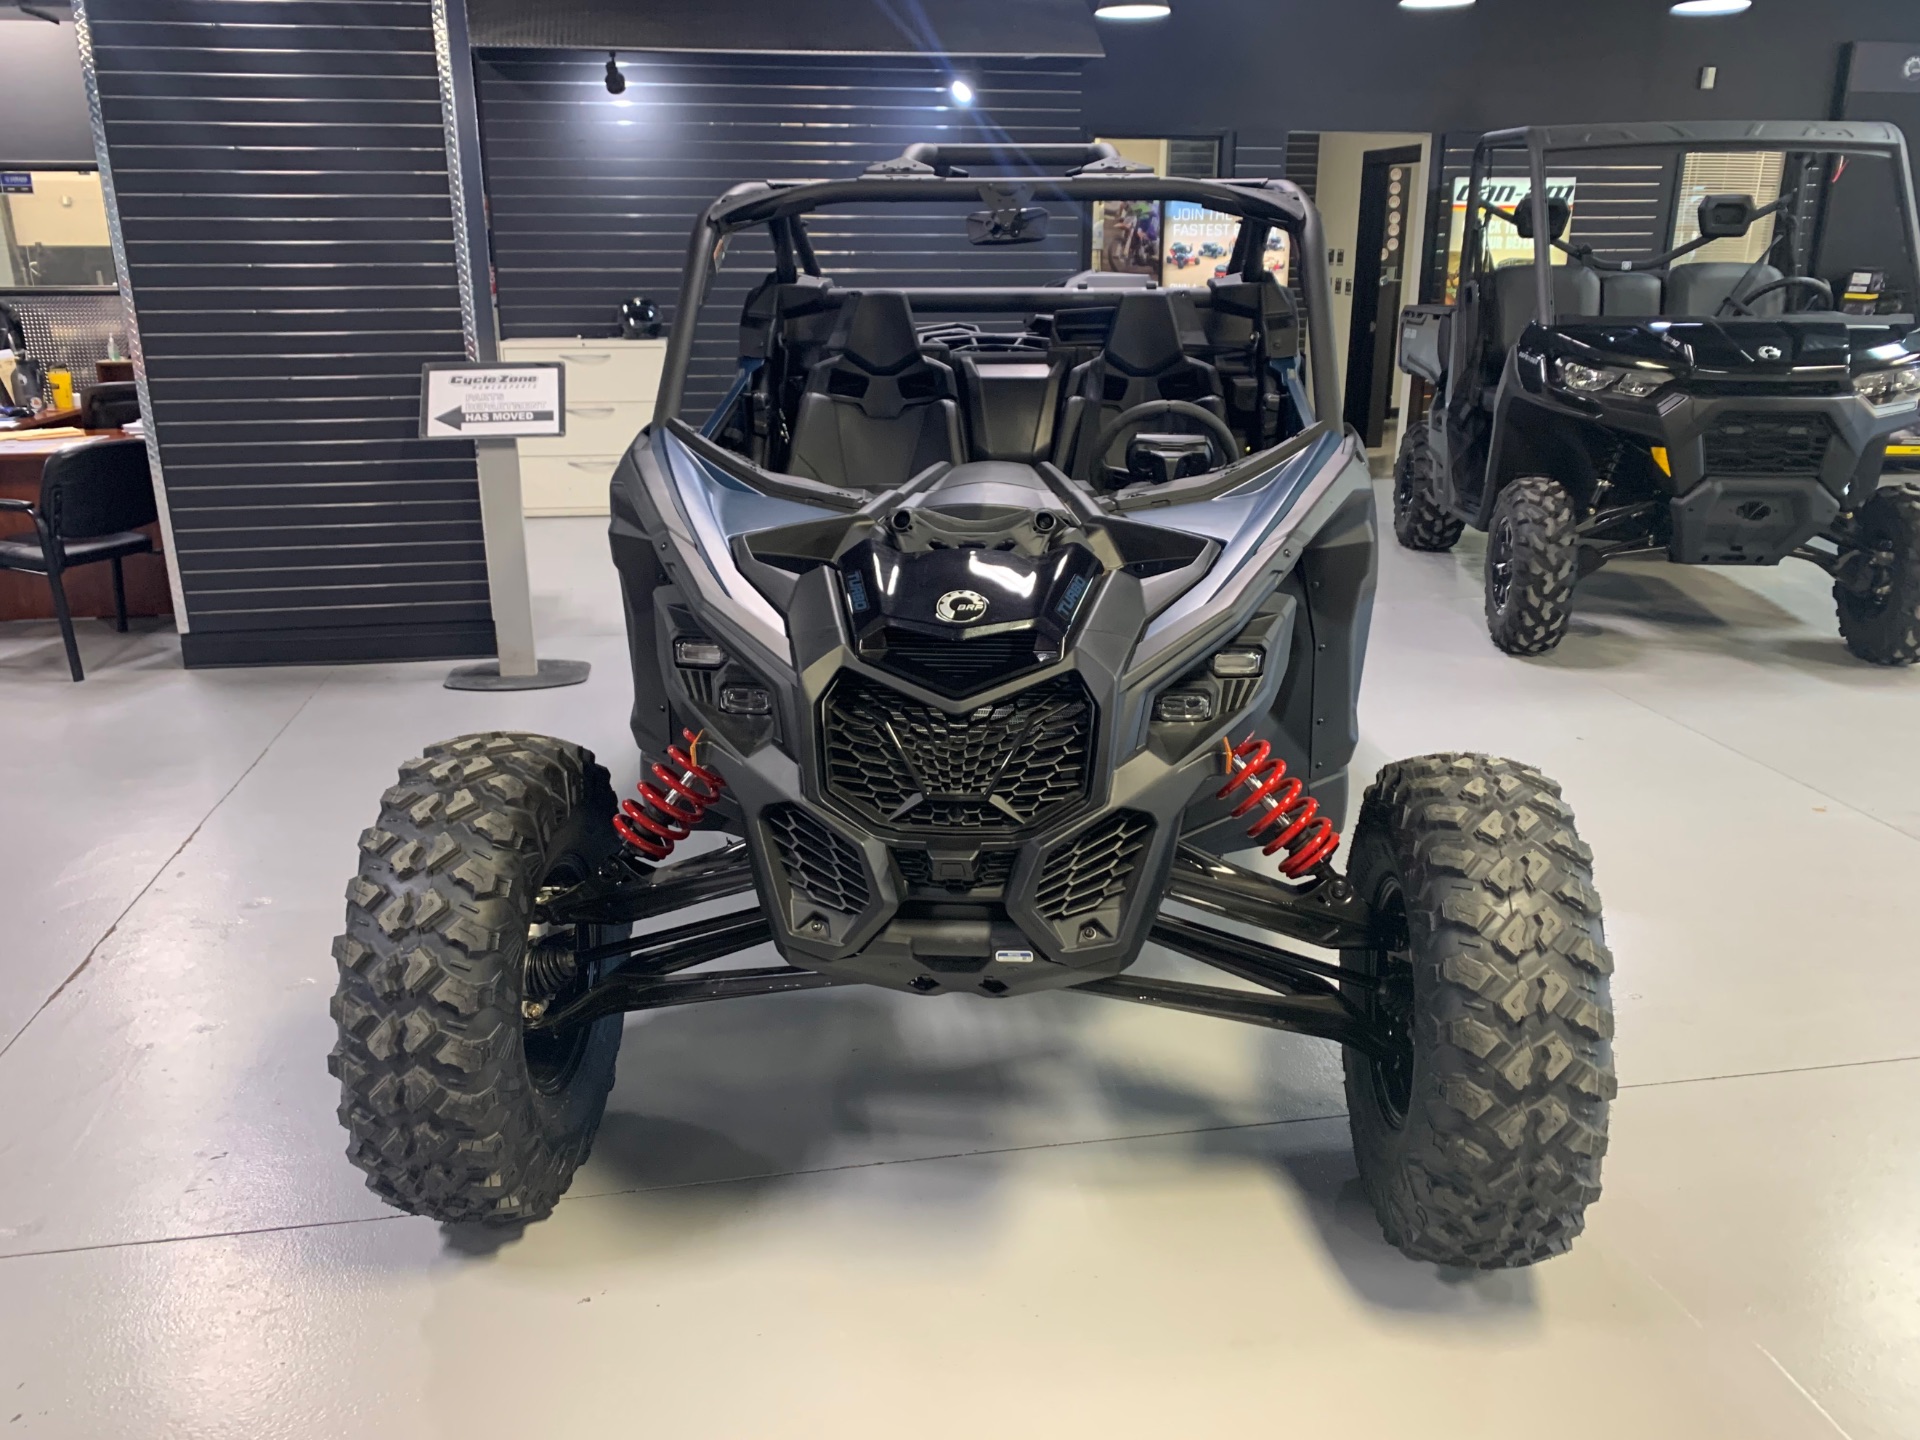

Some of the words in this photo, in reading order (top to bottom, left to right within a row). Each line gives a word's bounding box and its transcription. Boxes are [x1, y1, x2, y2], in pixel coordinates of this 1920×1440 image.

[1173, 208, 1203, 220] JOIN
[1173, 223, 1230, 236] FASTEST
[465, 412, 489, 422] HAS
[492, 411, 534, 421] MOVED
[848, 571, 867, 610] TURBO
[1057, 575, 1086, 616] TURBO
